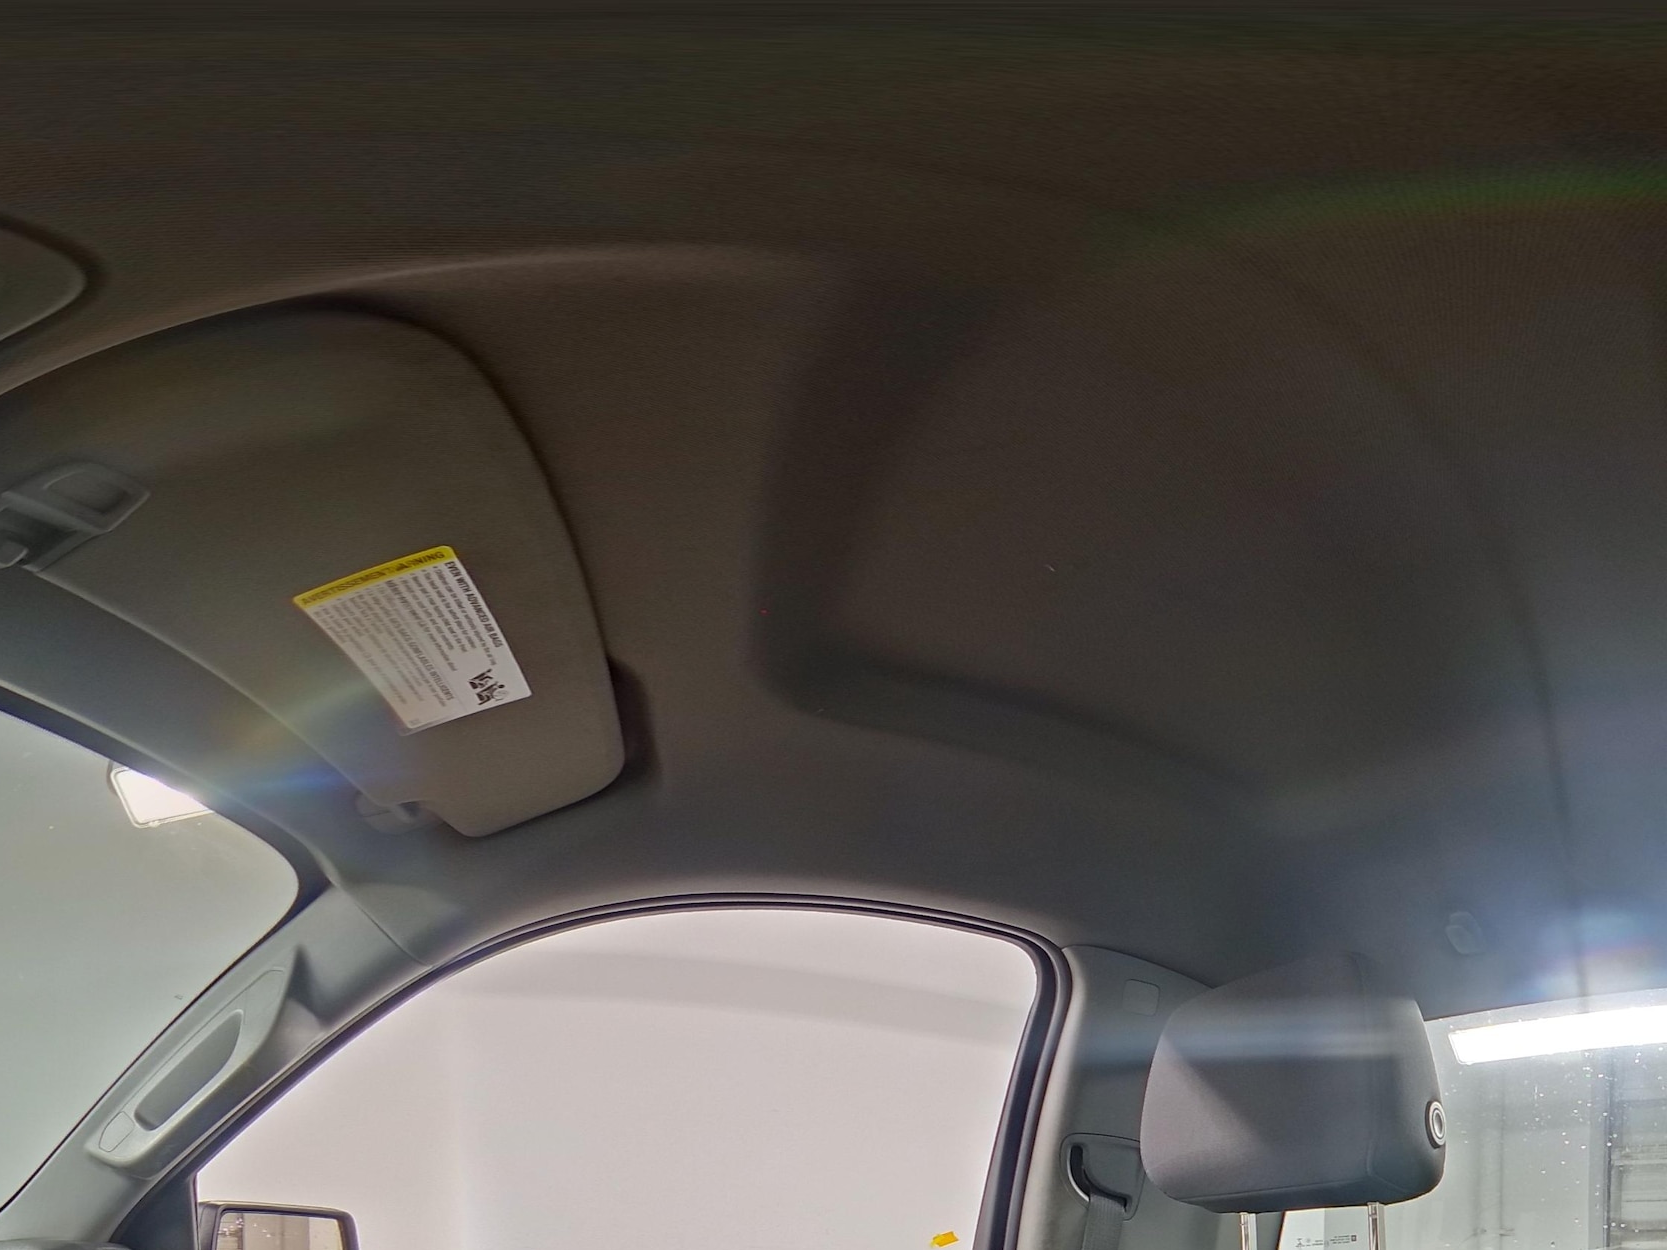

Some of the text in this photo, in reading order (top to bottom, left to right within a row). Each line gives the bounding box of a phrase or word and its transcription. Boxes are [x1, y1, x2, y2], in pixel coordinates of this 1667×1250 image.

[444, 559, 504, 648] EVEN WITH ADVANCED AIR BAGS
